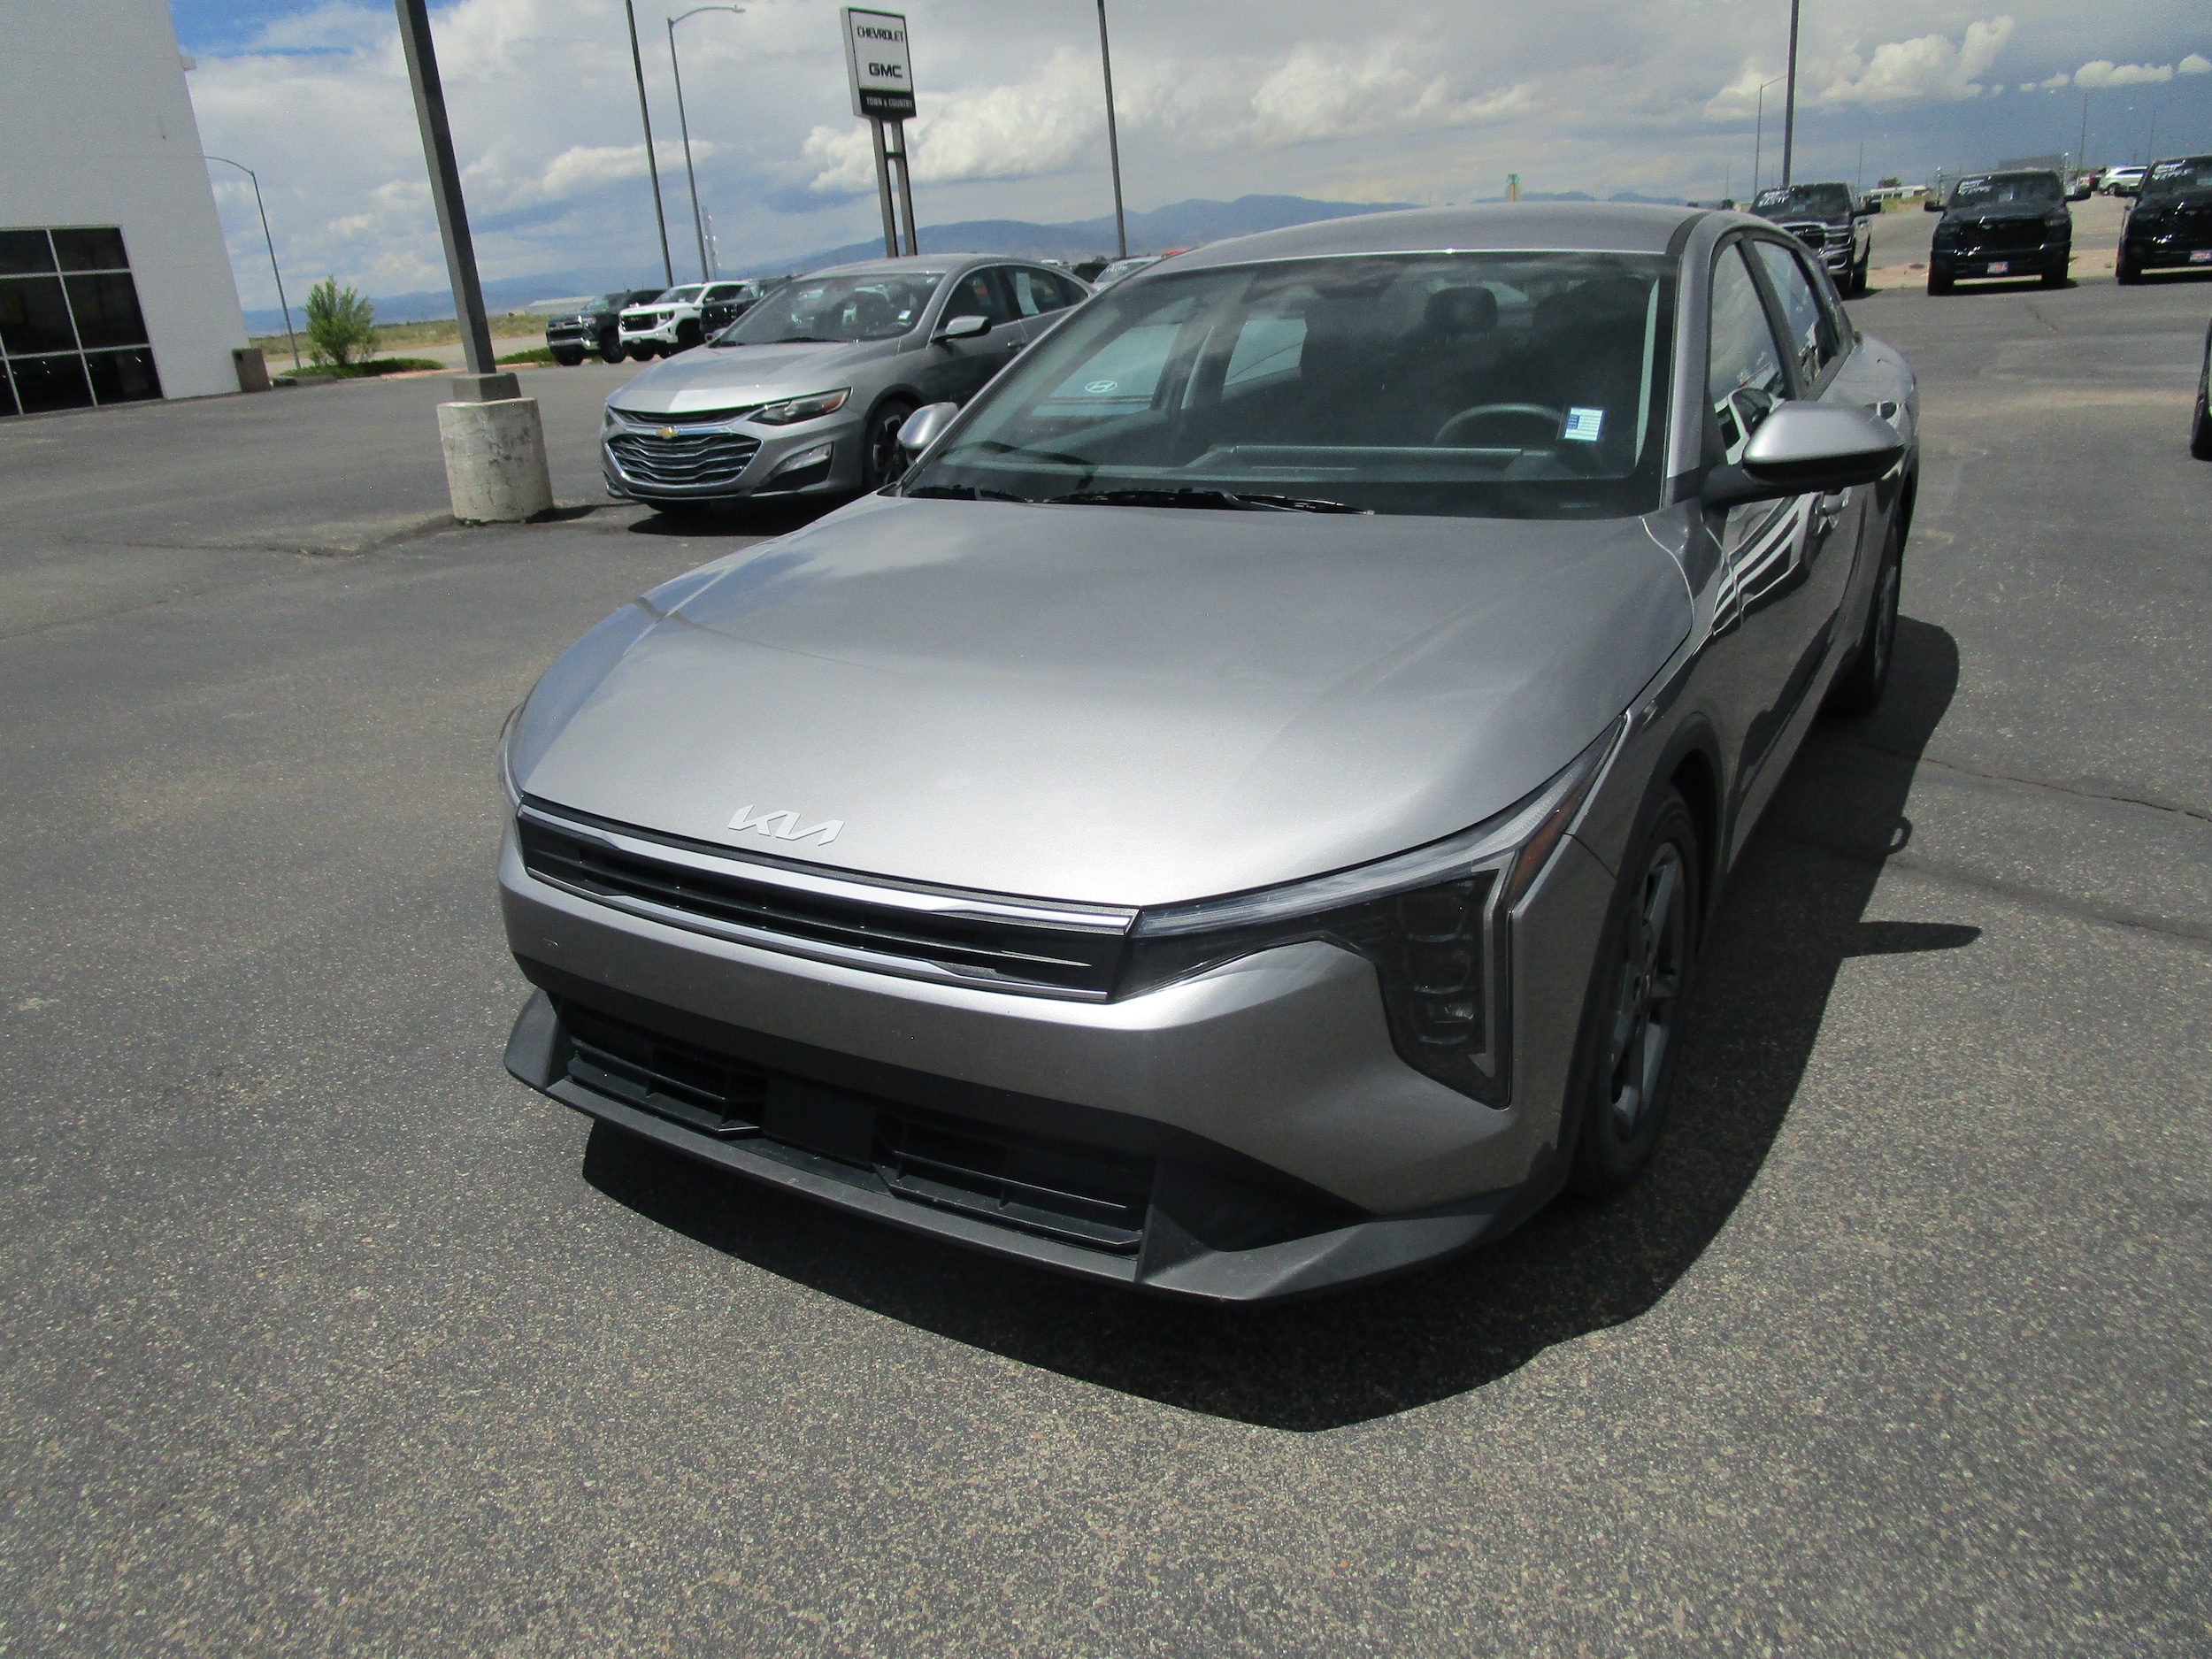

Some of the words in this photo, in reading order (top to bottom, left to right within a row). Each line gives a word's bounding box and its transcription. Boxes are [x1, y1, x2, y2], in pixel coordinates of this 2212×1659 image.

[856, 26, 903, 42] CHEVROLET
[869, 62, 902, 78] GMC
[727, 804, 845, 846] KIA
